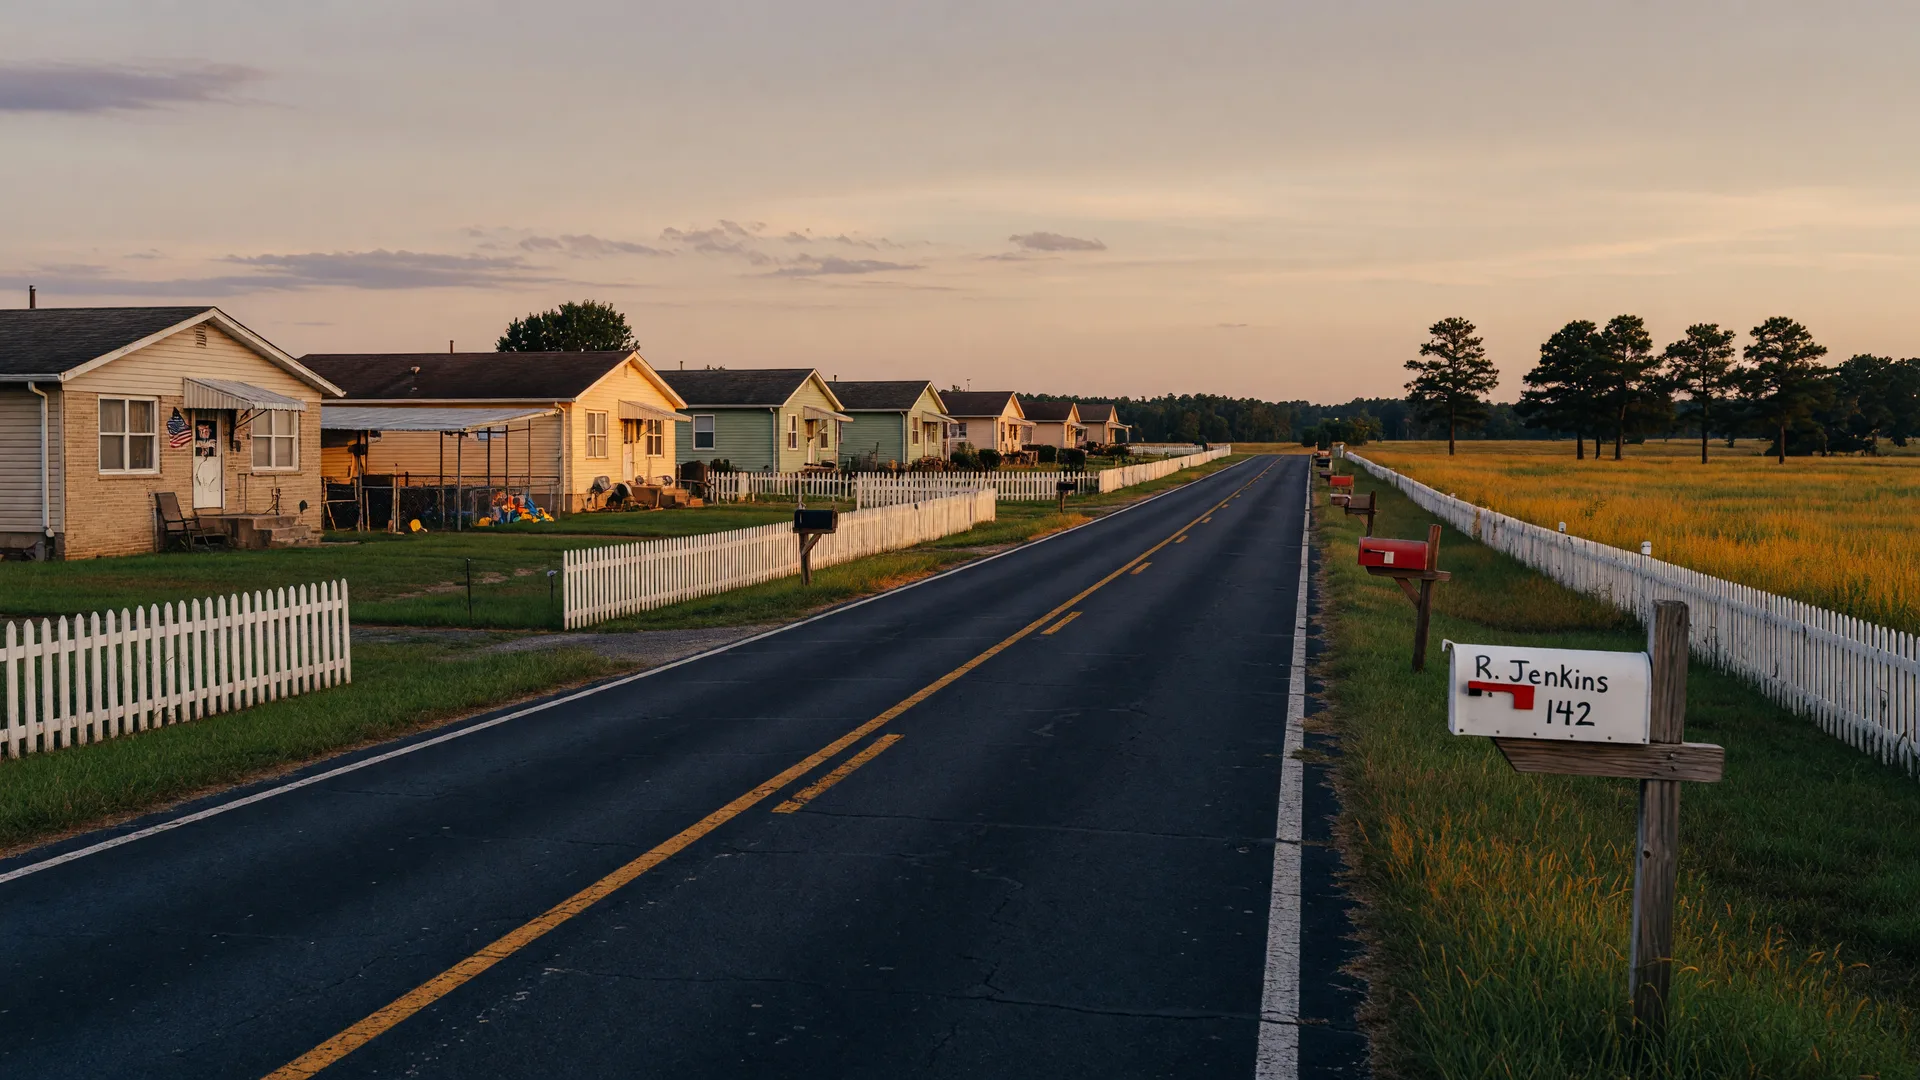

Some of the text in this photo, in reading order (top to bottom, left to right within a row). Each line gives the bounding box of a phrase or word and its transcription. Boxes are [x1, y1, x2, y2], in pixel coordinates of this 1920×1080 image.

[1475, 655, 1609, 694] R. Jenkins
[1546, 699, 1595, 727] 142
